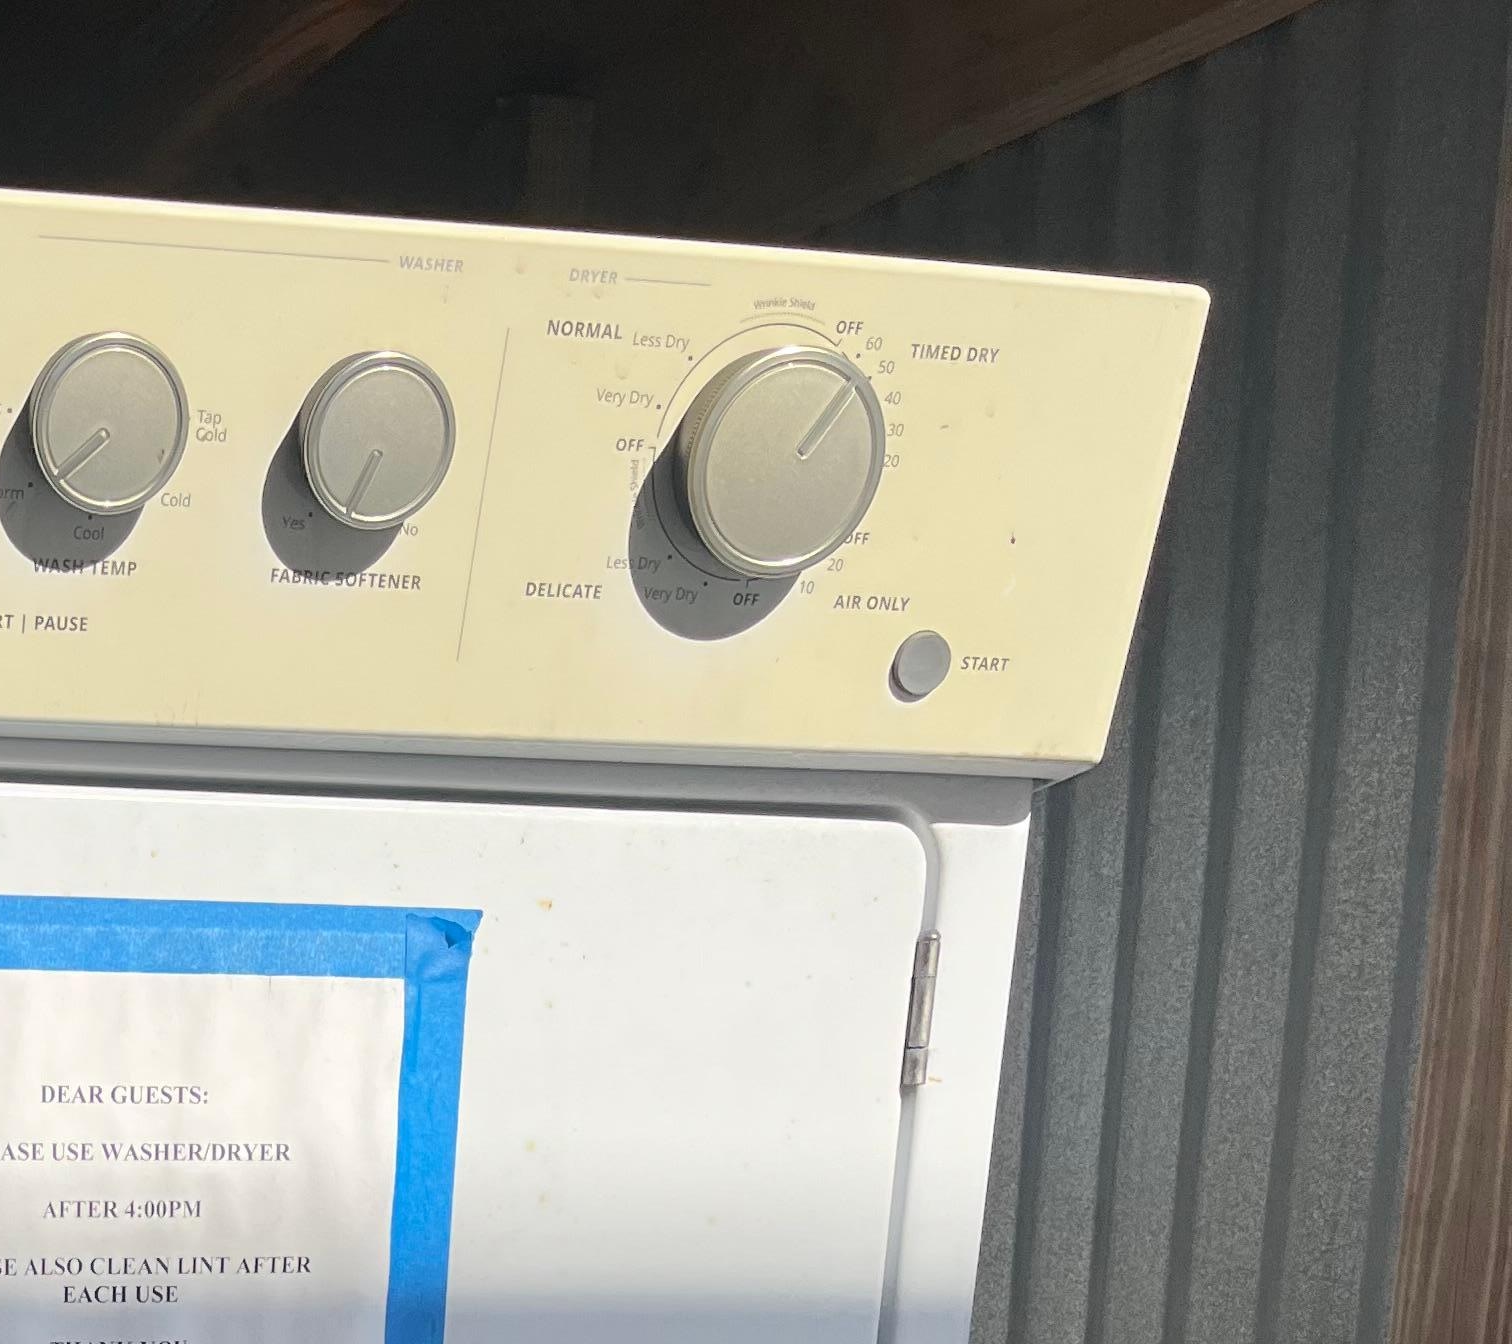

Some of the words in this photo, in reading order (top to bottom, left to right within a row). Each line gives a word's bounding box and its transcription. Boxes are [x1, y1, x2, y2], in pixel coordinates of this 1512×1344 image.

[399, 256, 464, 273] WASHER
[569, 268, 618, 285] DRYER
[546, 319, 622, 340] NORMAL
[836, 320, 864, 335] OFF
[633, 331, 661, 348] Less
[665, 334, 690, 353] Dry
[866, 337, 883, 350] 60
[910, 343, 961, 361] TIMED
[966, 346, 999, 364] DRY
[878, 361, 895, 374] 50
[597, 388, 626, 408] Very
[629, 390, 654, 409] Dry
[884, 391, 901, 405] 40
[197, 410, 222, 425] Tap
[196, 427, 227, 442] Cold
[887, 423, 904, 437] 30
[616, 438, 645, 453] OFF
[160, 492, 191, 507] Cold
[282, 516, 306, 531] Yes
[400, 523, 418, 536] No
[74, 525, 105, 541] Cool
[33, 557, 84, 574] WASH
[90, 560, 137, 576] TEMP
[607, 556, 634, 570] Less
[638, 556, 662, 574] Dry
[827, 558, 844, 572] 20
[271, 568, 330, 585] FABRIC
[335, 571, 421, 590] SOFTENER
[800, 581, 814, 594] 10
[525, 581, 603, 600] DELICATE
[644, 586, 673, 603] Very
[675, 587, 698, 605] Dry
[732, 593, 760, 606] OFF
[833, 595, 861, 610] AIR
[866, 596, 910, 612] ONLY
[34, 615, 88, 632] PAUSE
[961, 655, 1010, 673] START
[40, 1085, 105, 1105] DEAR
[110, 1085, 209, 1106] GUESTS:
[51, 1143, 94, 1162] USE
[102, 1142, 291, 1162] WASHER/DRYER
[42, 1200, 118, 1219] AFTER
[124, 1200, 202, 1219] 4:00PM
[24, 1257, 83, 1276] ALSO
[90, 1257, 169, 1276] CLEAN
[177, 1256, 229, 1275] LINT
[236, 1255, 311, 1275] AFTER
[63, 1285, 127, 1304] EACH
[136, 1285, 178, 1303] USE
